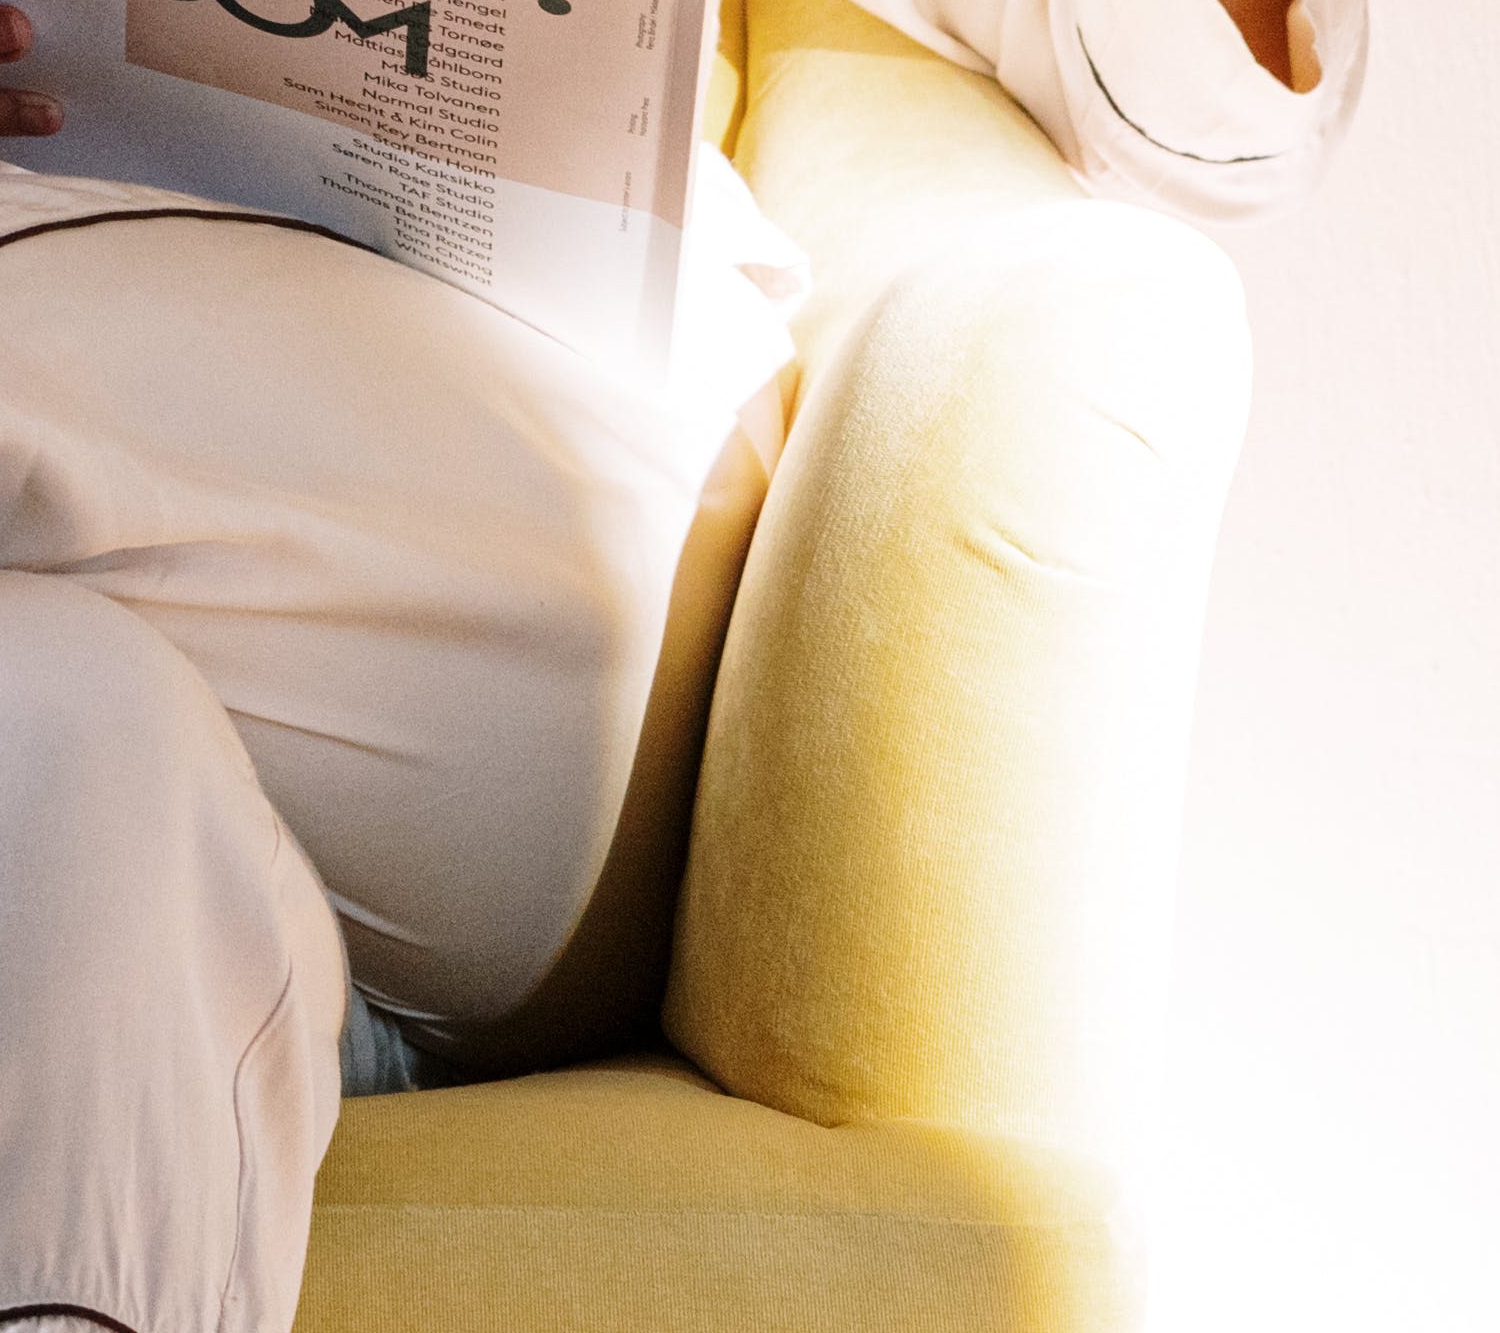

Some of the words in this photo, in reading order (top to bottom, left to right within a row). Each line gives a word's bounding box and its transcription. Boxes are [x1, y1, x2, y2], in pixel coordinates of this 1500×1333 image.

[334, 29, 406, 59] Mattias
[440, 25, 505, 52] Tornøe
[443, 10, 506, 36] Smedt
[361, 87, 434, 116] Normal
[438, 108, 500, 133] Studio
[363, 71, 409, 94] Mika
[414, 84, 501, 117] Tolvanen
[440, 74, 502, 101] Studio
[282, 76, 325, 98] Sam
[330, 90, 386, 118] Hecht
[390, 112, 404, 124] &
[408, 116, 446, 136] Kim
[450, 128, 499, 149] Colin
[314, 99, 372, 127] Simon
[376, 121, 411, 141] Key
[415, 133, 497, 165] Bertman
[331, 143, 384, 170] Søren
[388, 165, 431, 188] Rose
[435, 183, 495, 210] Studio
[352, 137, 411, 168] Studio
[415, 163, 496, 195] Kaksikko
[372, 132, 441, 165] Staffan
[446, 157, 496, 180] Holm
[319, 174, 391, 210] Thomas
[395, 204, 494, 251] Bernstrand
[343, 172, 415, 209] Thomas
[419, 203, 494, 238] Bentzen
[399, 183, 433, 200] TAF
[435, 197, 495, 224] Studio
[393, 215, 432, 239] Tina
[435, 233, 493, 263] Ratzer
[394, 227, 432, 250] Tom
[435, 246, 493, 277] Chung
[394, 239, 492, 287] Whatswhat
